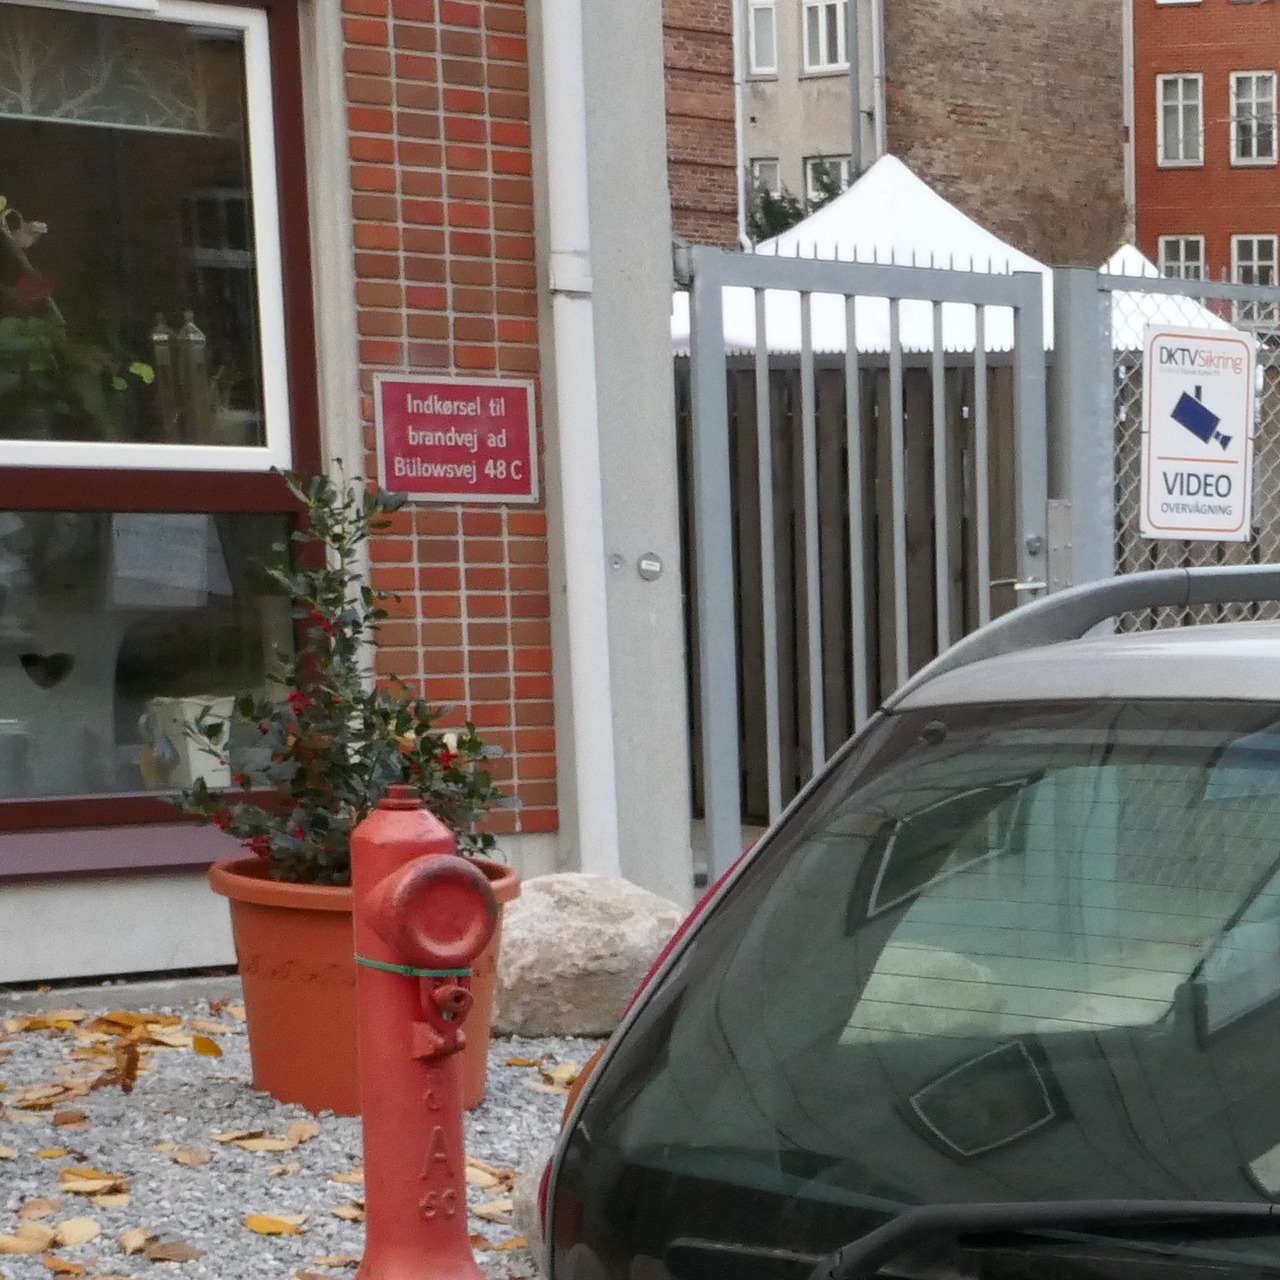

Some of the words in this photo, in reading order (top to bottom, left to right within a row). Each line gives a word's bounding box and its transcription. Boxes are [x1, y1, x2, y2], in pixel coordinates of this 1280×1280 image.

[406, 393, 480, 416] Indkørsel
[489, 397, 506, 417] til
[408, 426, 478, 453] brandvej
[487, 429, 507, 448] ad
[394, 457, 477, 484] Bülowsvej
[484, 460, 507, 479] 48
[511, 460, 523, 480] C
[1162, 471, 1233, 498] VIDEO
[1160, 501, 1233, 516] OVERVÅGNING
